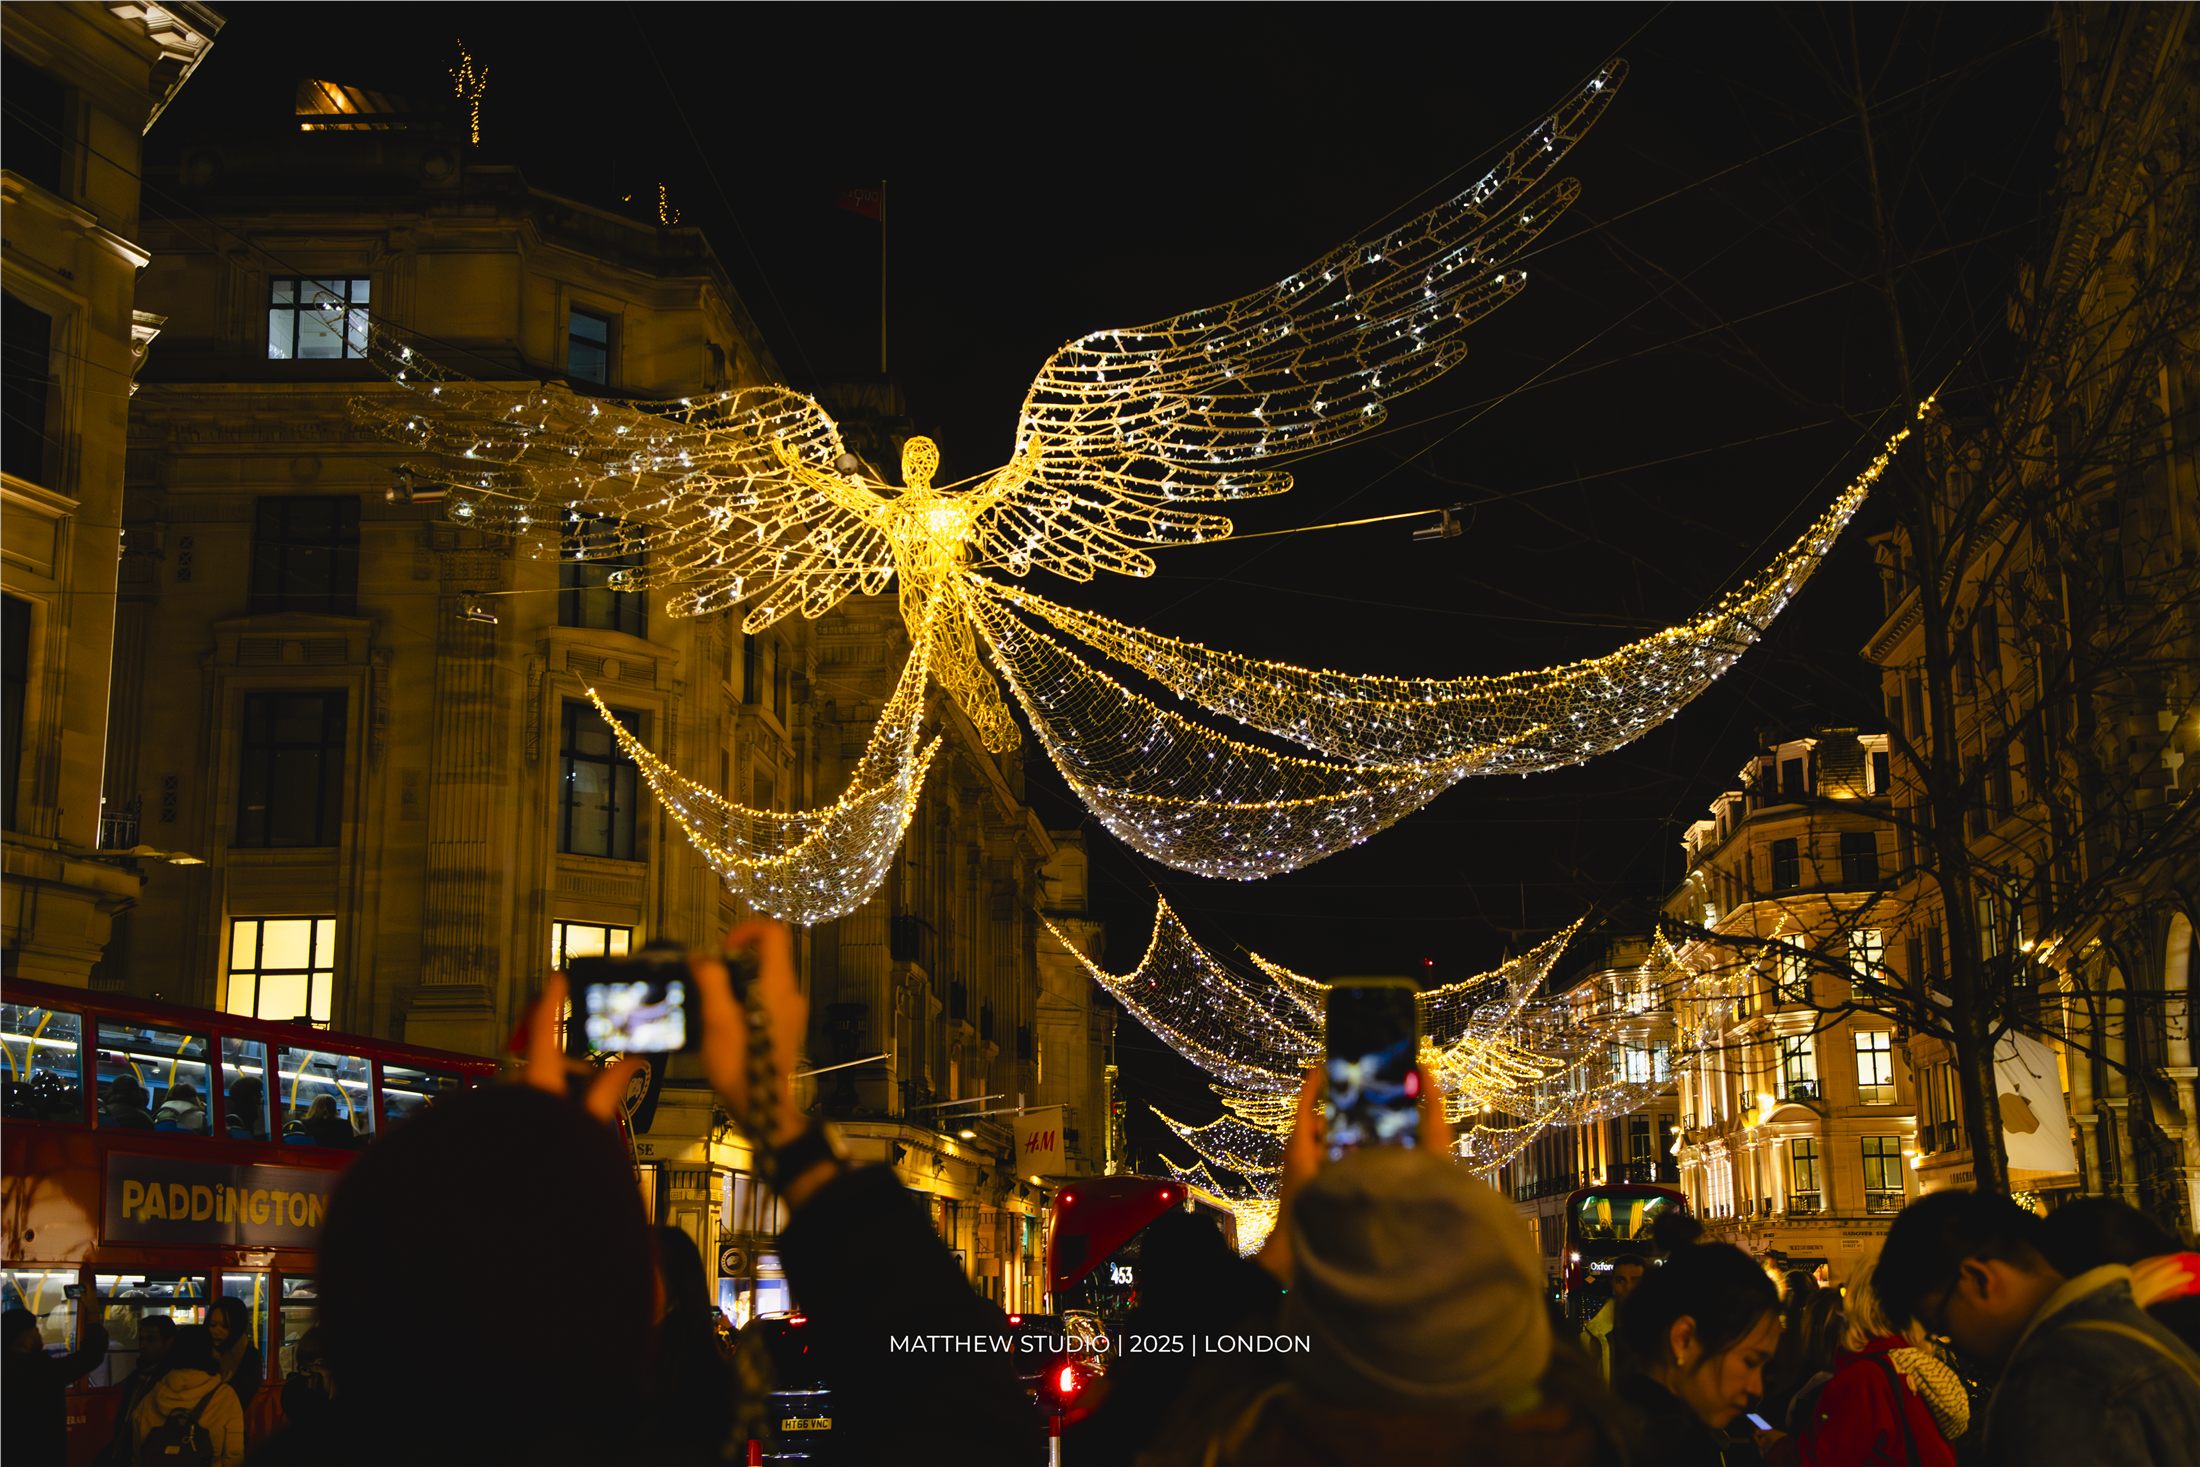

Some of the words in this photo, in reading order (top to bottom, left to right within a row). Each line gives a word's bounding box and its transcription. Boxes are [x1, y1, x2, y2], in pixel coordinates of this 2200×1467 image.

[1025, 1131, 1055, 1153] H&M
[1110, 1266, 1134, 1285] 453
[811, 1419, 828, 1428] VNC
